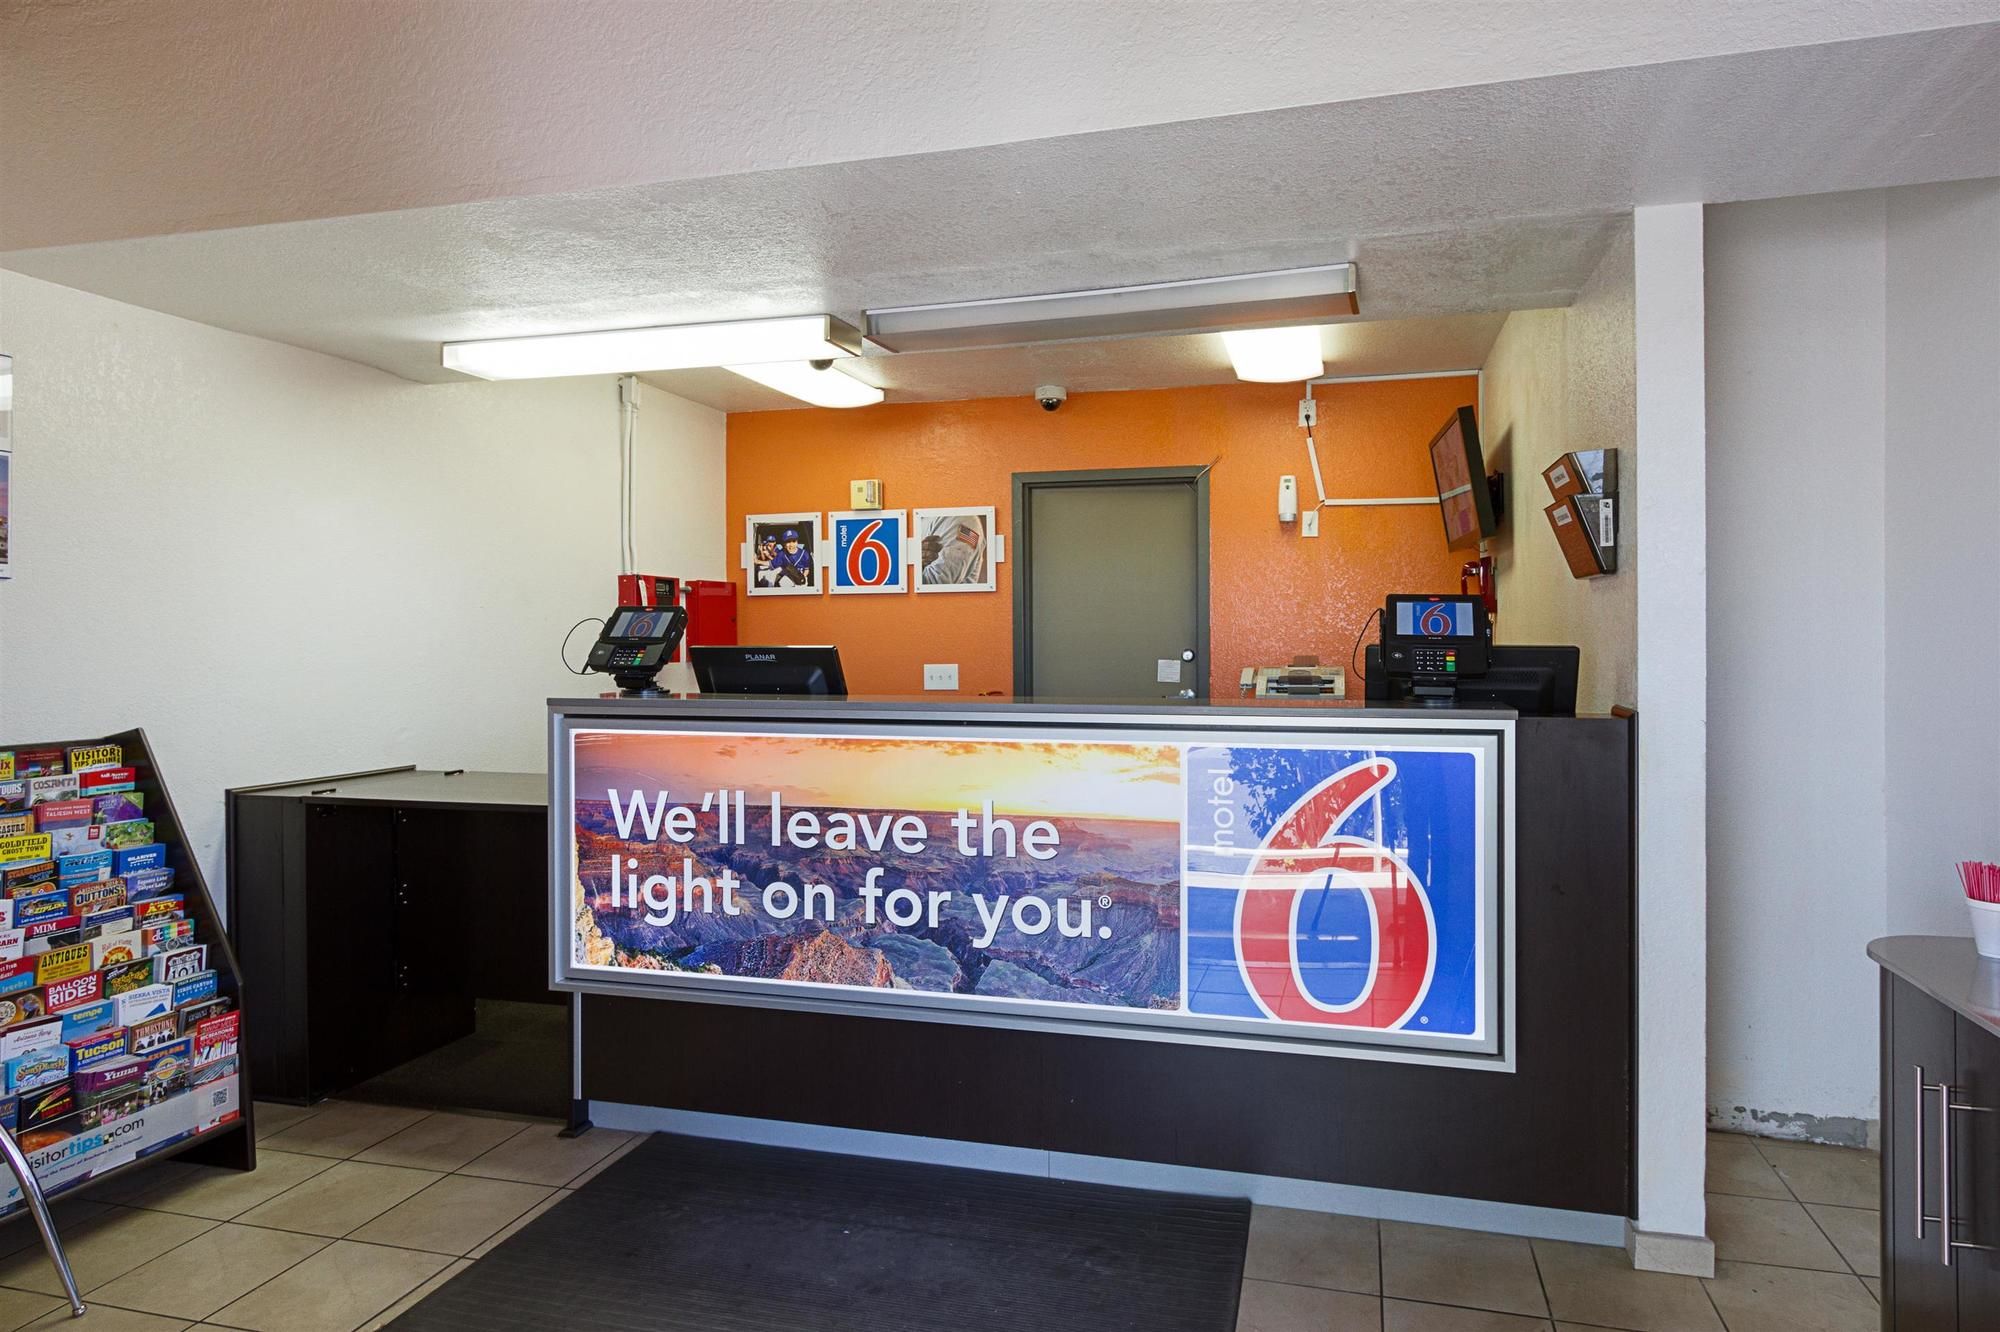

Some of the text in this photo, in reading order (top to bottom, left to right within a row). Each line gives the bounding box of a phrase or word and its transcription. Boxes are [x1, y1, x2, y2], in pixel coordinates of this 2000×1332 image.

[846, 520, 892, 586] 6
[628, 612, 656, 637] 6
[1420, 603, 1452, 636] 6
[73, 748, 116, 761] VISITOR
[1207, 769, 1234, 856] motel
[608, 788, 1060, 860] We’ll leave the
[0, 837, 48, 849] GOLDFIELD
[2, 847, 23, 855] GHOST
[611, 854, 741, 927] light
[762, 881, 835, 921] on
[859, 867, 951, 928] for
[1233, 757, 1437, 1031] 6
[33, 922, 57, 935] MIM
[41, 946, 88, 969] ANTIQUES
[48, 974, 97, 995] BALLOON
[49, 982, 97, 1007] RIDES
[73, 1007, 103, 1021] tempe
[135, 1019, 174, 1038] TOMBSTONE
[76, 1039, 124, 1060] Tucson
[104, 1066, 138, 1081] Yuma
